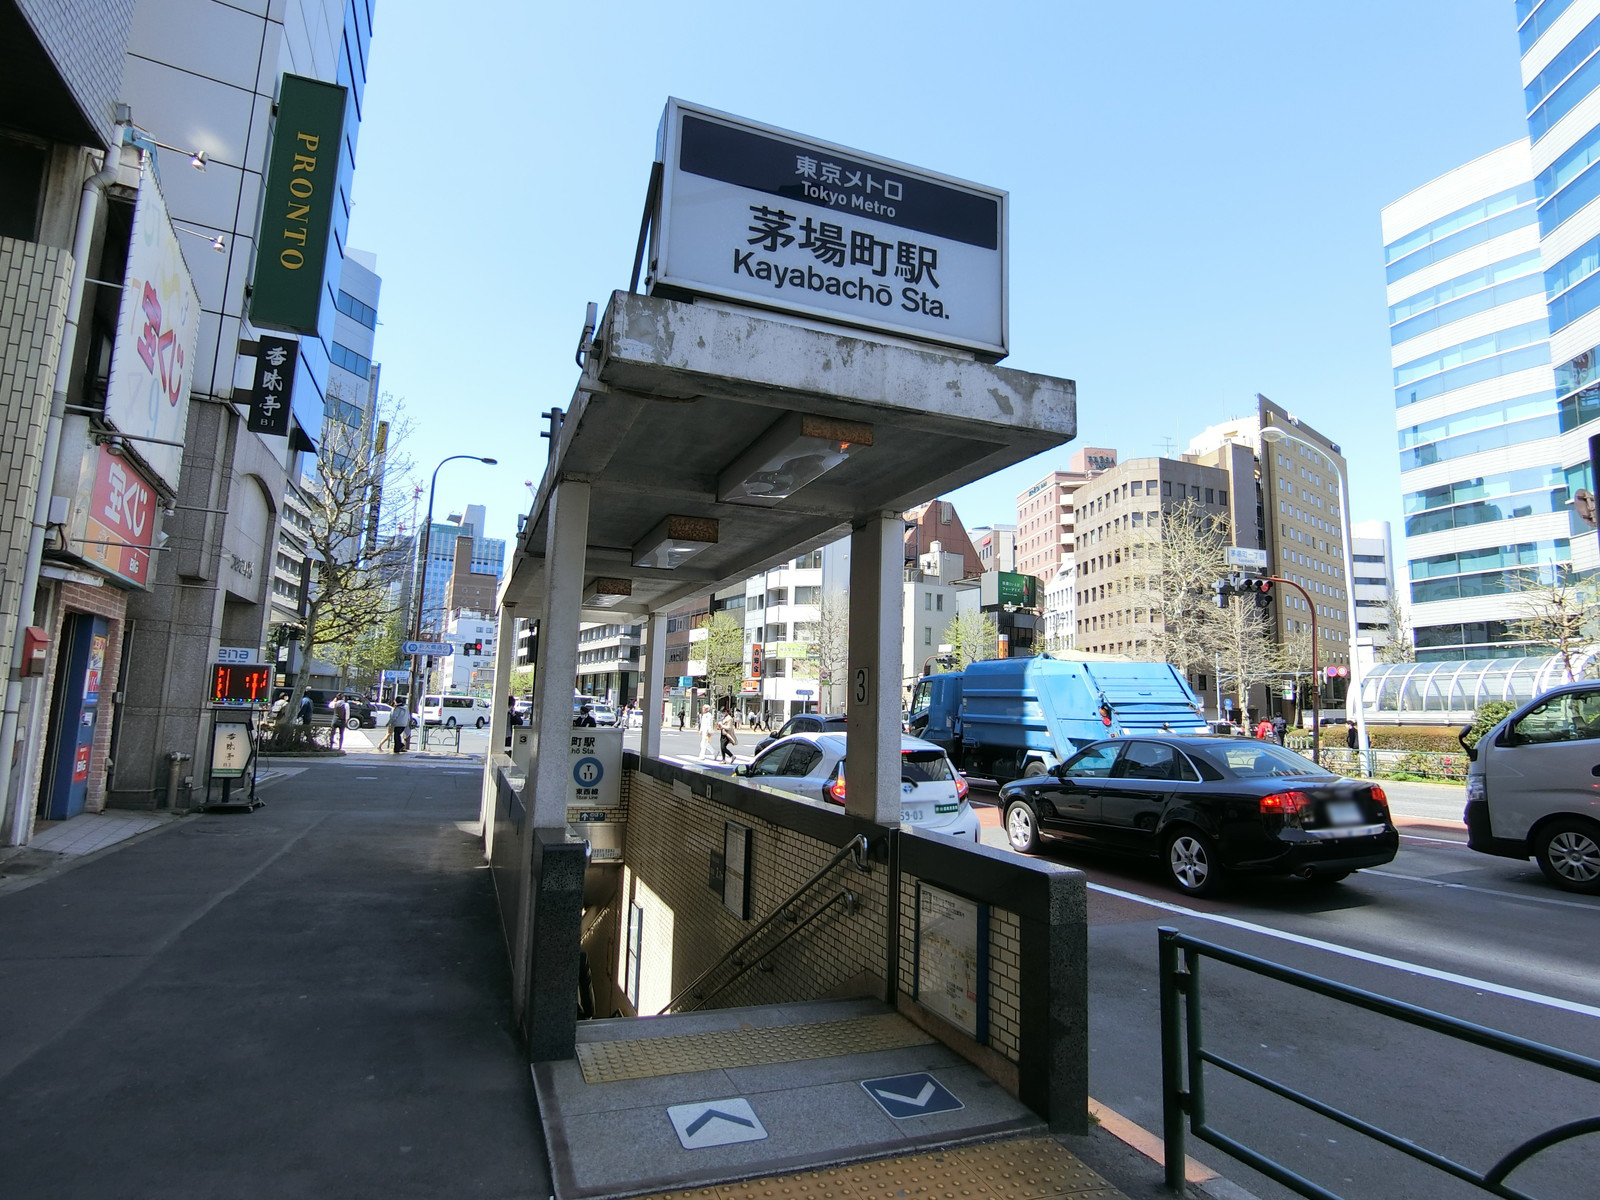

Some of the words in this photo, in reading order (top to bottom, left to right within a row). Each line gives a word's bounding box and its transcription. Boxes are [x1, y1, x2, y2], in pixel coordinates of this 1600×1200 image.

[280, 132, 320, 270] PRONTO
[795, 154, 904, 202] 東京メトロ
[801, 180, 847, 207] Tokyo
[851, 194, 897, 218] Metro
[747, 204, 941, 289] 茅場町駅
[733, 248, 893, 307] Kayabachō
[901, 287, 950, 320] Sta.
[137, 280, 184, 407] 宝くじ
[259, 346, 288, 417] 香味亭
[104, 462, 148, 537] 宝くじ
[129, 557, 139, 574] BIG
[856, 669, 866, 703] 3
[76, 760, 87, 773] BIG
[520, 735, 527, 743] 3
